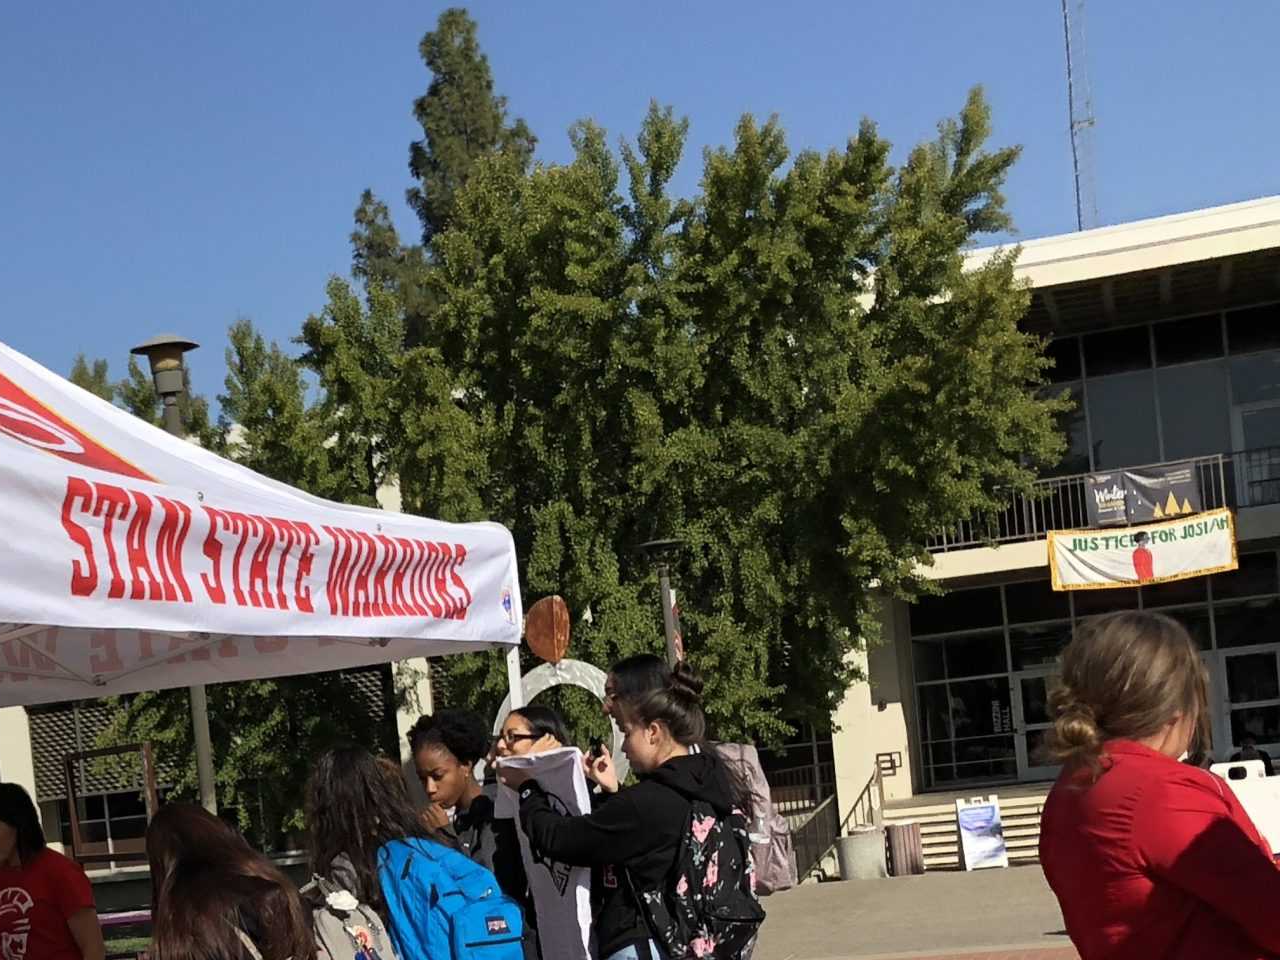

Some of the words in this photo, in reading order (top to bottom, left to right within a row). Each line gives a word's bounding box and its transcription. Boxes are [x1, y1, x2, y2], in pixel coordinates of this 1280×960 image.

[61, 476, 193, 603] STAN
[200, 509, 321, 613] STATE
[324, 524, 472, 620] WARRIORS
[1151, 529, 1177, 545] FOR
[1180, 514, 1229, 540] JOSIAH
